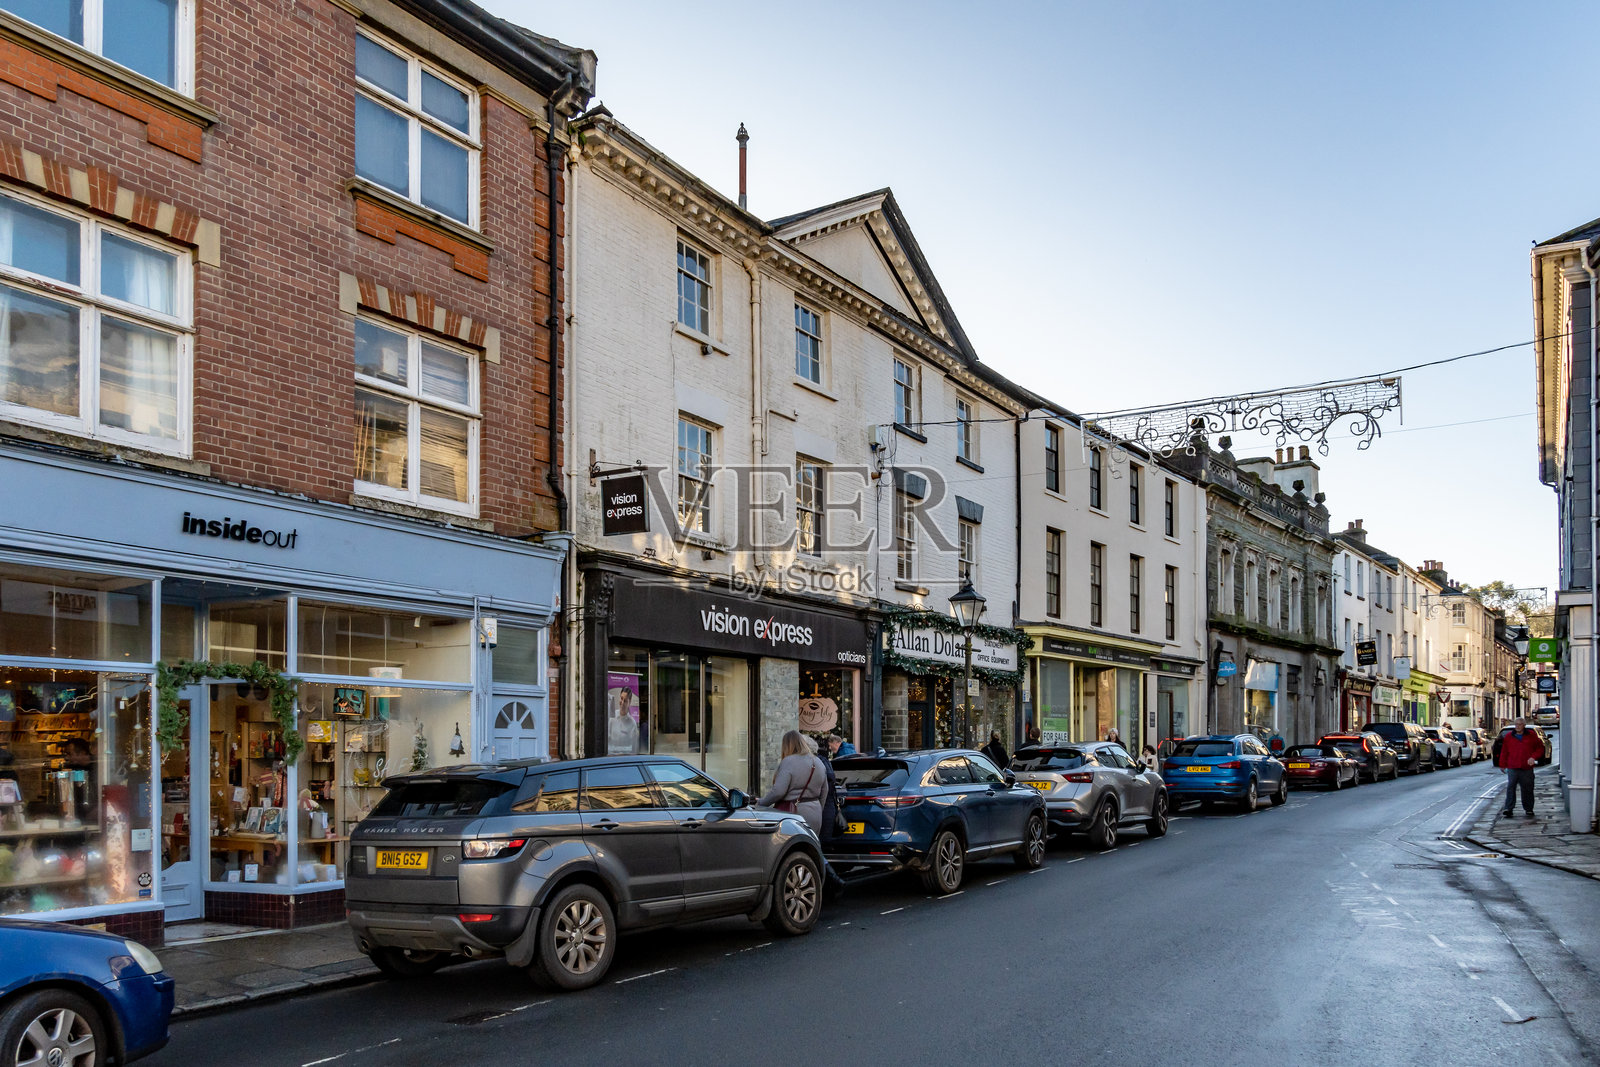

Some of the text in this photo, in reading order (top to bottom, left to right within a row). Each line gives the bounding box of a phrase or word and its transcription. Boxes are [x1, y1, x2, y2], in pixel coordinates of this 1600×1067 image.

[611, 493, 638, 505] vision
[606, 506, 643, 519] express
[182, 511, 298, 549] insideout
[700, 604, 813, 647] vision express
[895, 625, 930, 653] Allan
[837, 651, 866, 664] opticians
[977, 654, 1010, 665] OFFICE EQUIPMENT
[1043, 732, 1067, 741] FOR SALE
[381, 853, 401, 866] BN15
[402, 853, 423, 866] GSZ
